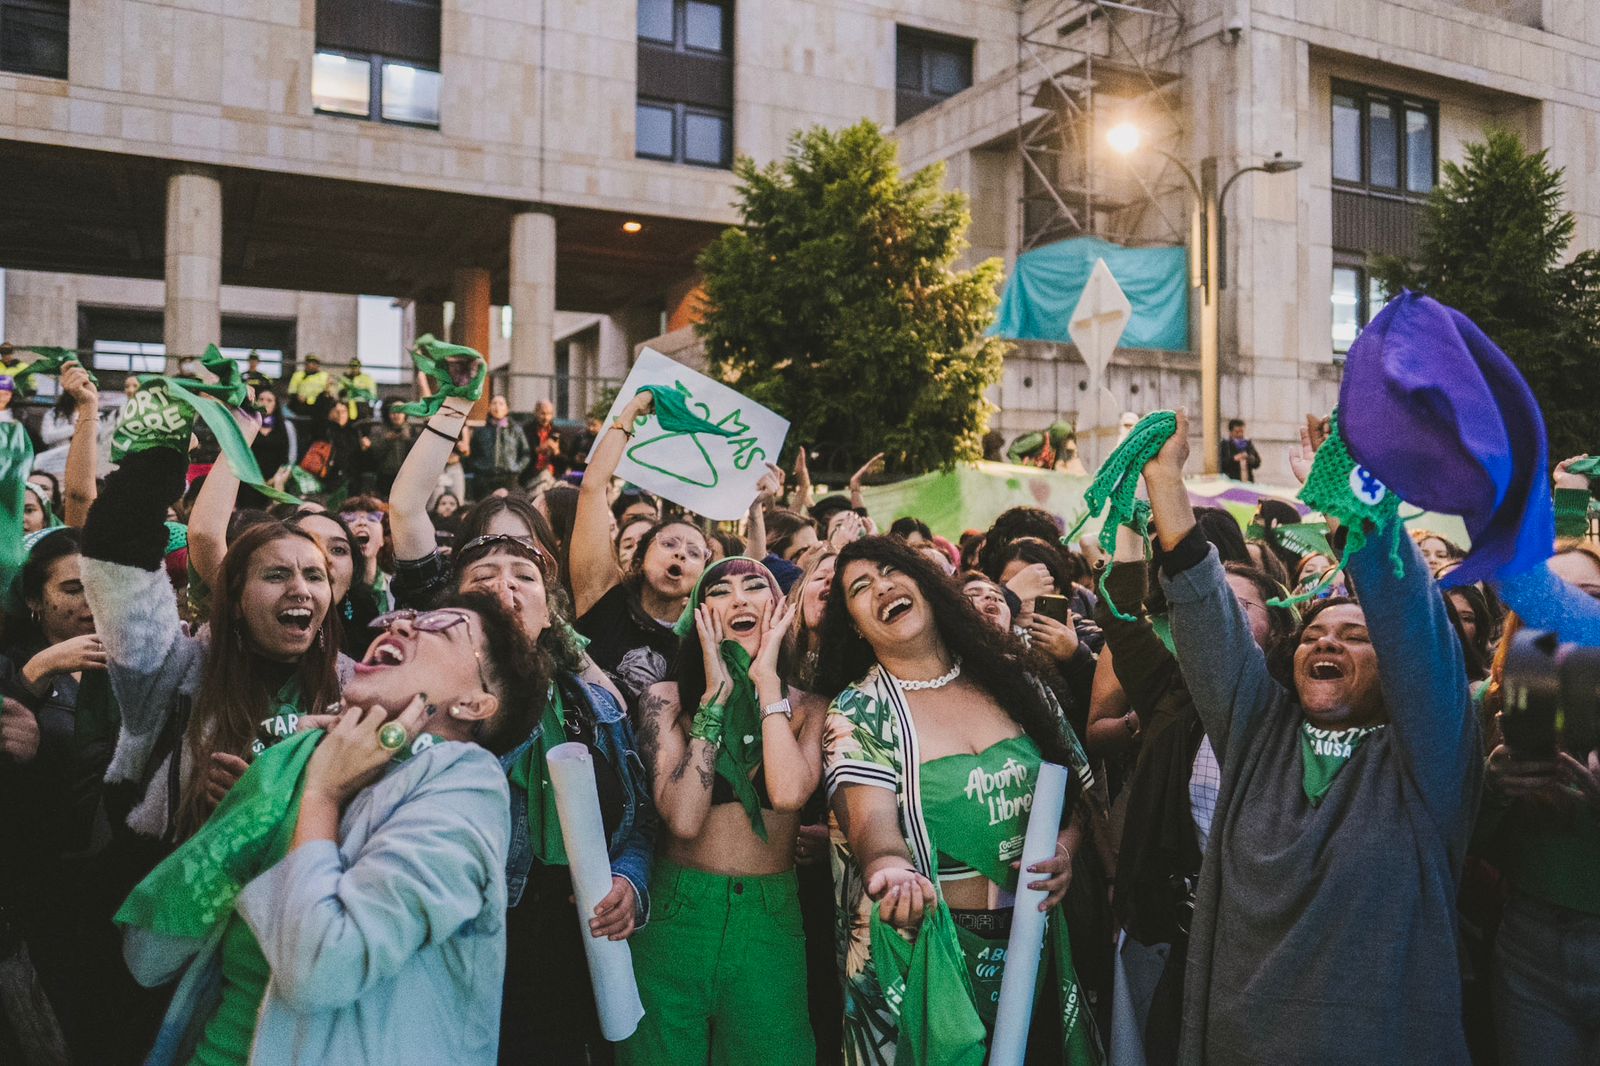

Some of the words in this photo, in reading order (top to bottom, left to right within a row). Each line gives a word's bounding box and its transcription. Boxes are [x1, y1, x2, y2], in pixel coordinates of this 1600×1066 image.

[112, 406, 187, 452] LIBRE
[963, 757, 1027, 804] Aborto
[988, 789, 1033, 826] Libre
